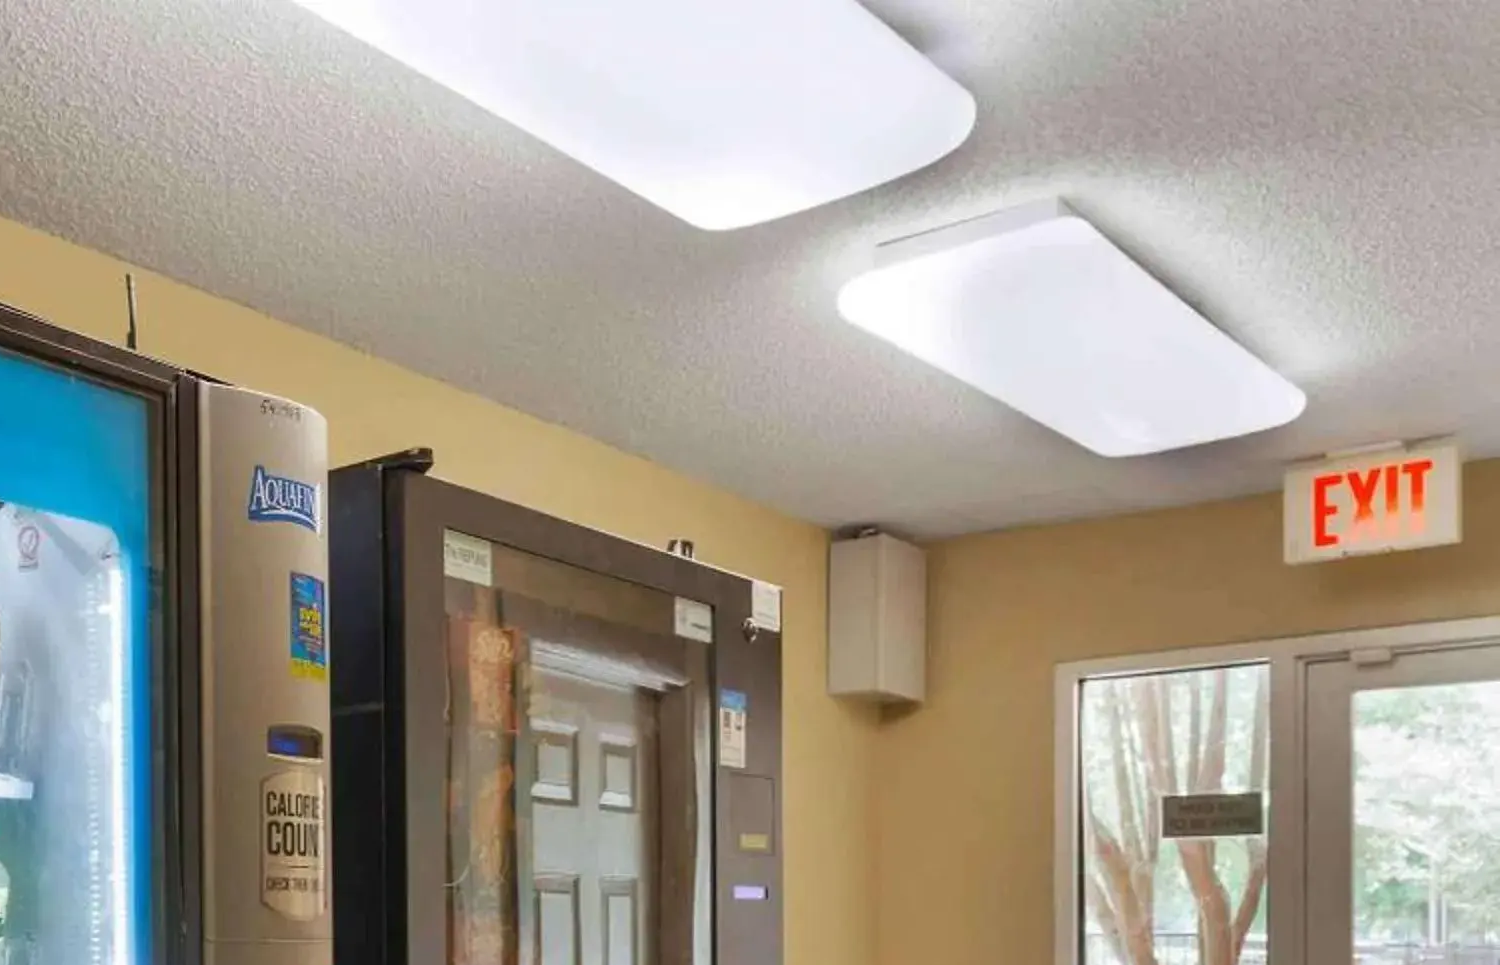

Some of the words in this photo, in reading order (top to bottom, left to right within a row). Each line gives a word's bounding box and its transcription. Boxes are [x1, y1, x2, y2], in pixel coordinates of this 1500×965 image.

[1313, 459, 1433, 547] EXIT
[266, 791, 319, 819] CALORIE
[268, 822, 319, 858] COUN
